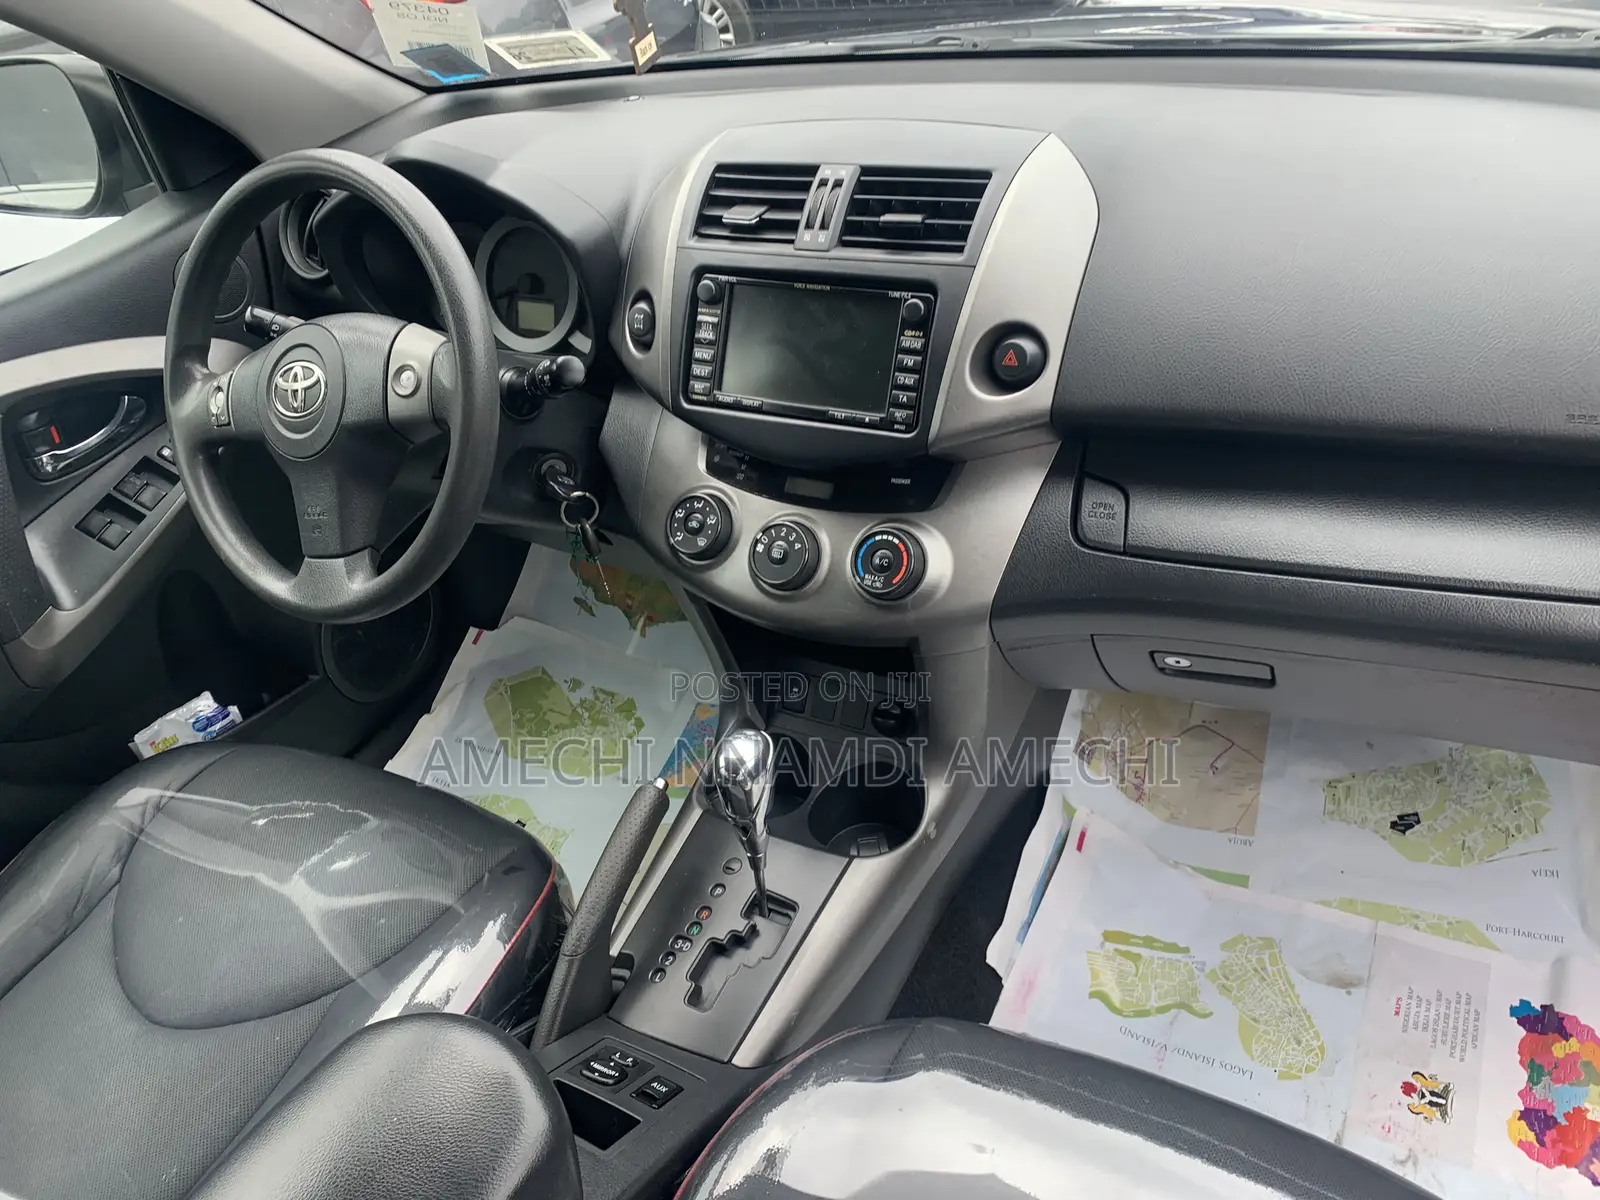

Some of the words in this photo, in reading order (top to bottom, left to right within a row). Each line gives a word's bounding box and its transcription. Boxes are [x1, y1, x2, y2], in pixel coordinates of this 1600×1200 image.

[694, 350, 712, 361] MENU
[902, 358, 914, 367] FM
[692, 368, 709, 377] DEST
[898, 394, 908, 403] TA
[1091, 502, 1115, 512] OPEN
[1088, 511, 1117, 521] CLOSE
[761, 535, 769, 544] 0
[771, 528, 776, 538] 1
[780, 527, 787, 537] 2
[788, 532, 797, 541] 3
[794, 542, 802, 550] 4
[874, 557, 889, 567] A/C
[1228, 837, 1255, 848] ABUJA
[1531, 868, 1560, 879] IKEJA
[713, 887, 723, 896] P
[700, 910, 709, 920] R
[690, 925, 700, 935] N
[1485, 923, 1565, 944] PORT-HARCOURT
[664, 955, 673, 966] 2
[655, 973, 661, 982] L
[1455, 990, 1463, 1005] MAP
[1394, 996, 1402, 1016] MAPS
[1402, 1001, 1411, 1033] NIGERIAN
[1412, 1010, 1421, 1032] ABUJA
[1473, 1008, 1481, 1023] MAP
[1461, 1007, 1471, 1039] POLITICAL
[1119, 1025, 1169, 1052] V/ISLAND
[1430, 1027, 1439, 1049] LAGOS
[1459, 1038, 1468, 1062] WORLD
[593, 1062, 616, 1076] MIRROR
[1219, 1061, 1254, 1080] LAGOS
[650, 1081, 669, 1093] AUX
